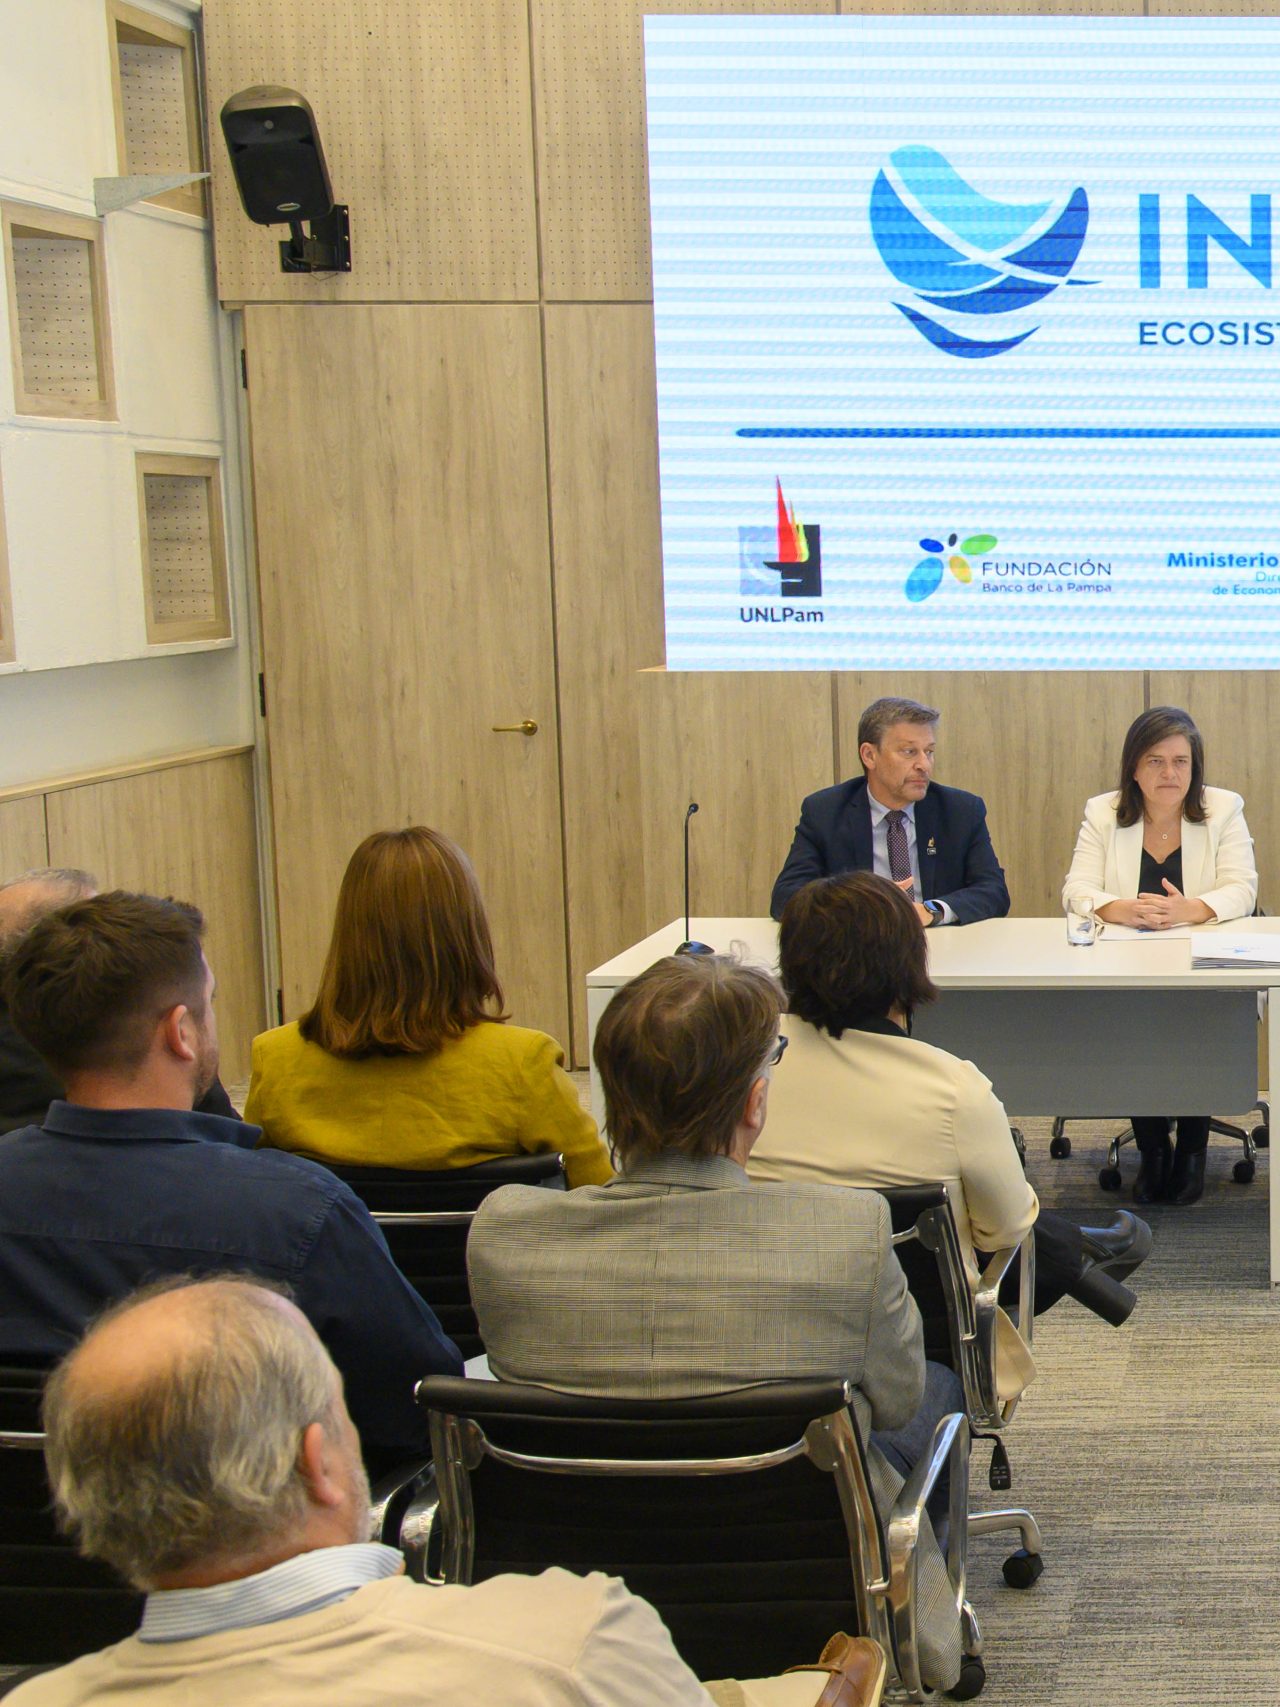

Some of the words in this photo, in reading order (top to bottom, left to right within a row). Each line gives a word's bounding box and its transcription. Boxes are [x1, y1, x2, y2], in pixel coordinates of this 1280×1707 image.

[982, 558, 1112, 577] FUNDACIÓN
[1167, 552, 1279, 568] Ministerio
[982, 582, 1023, 593] Banco
[1027, 582, 1043, 593] de
[1048, 582, 1063, 593] La
[1067, 582, 1113, 595] Pampa
[1212, 583, 1229, 596] de
[740, 607, 824, 622] UNLPam
